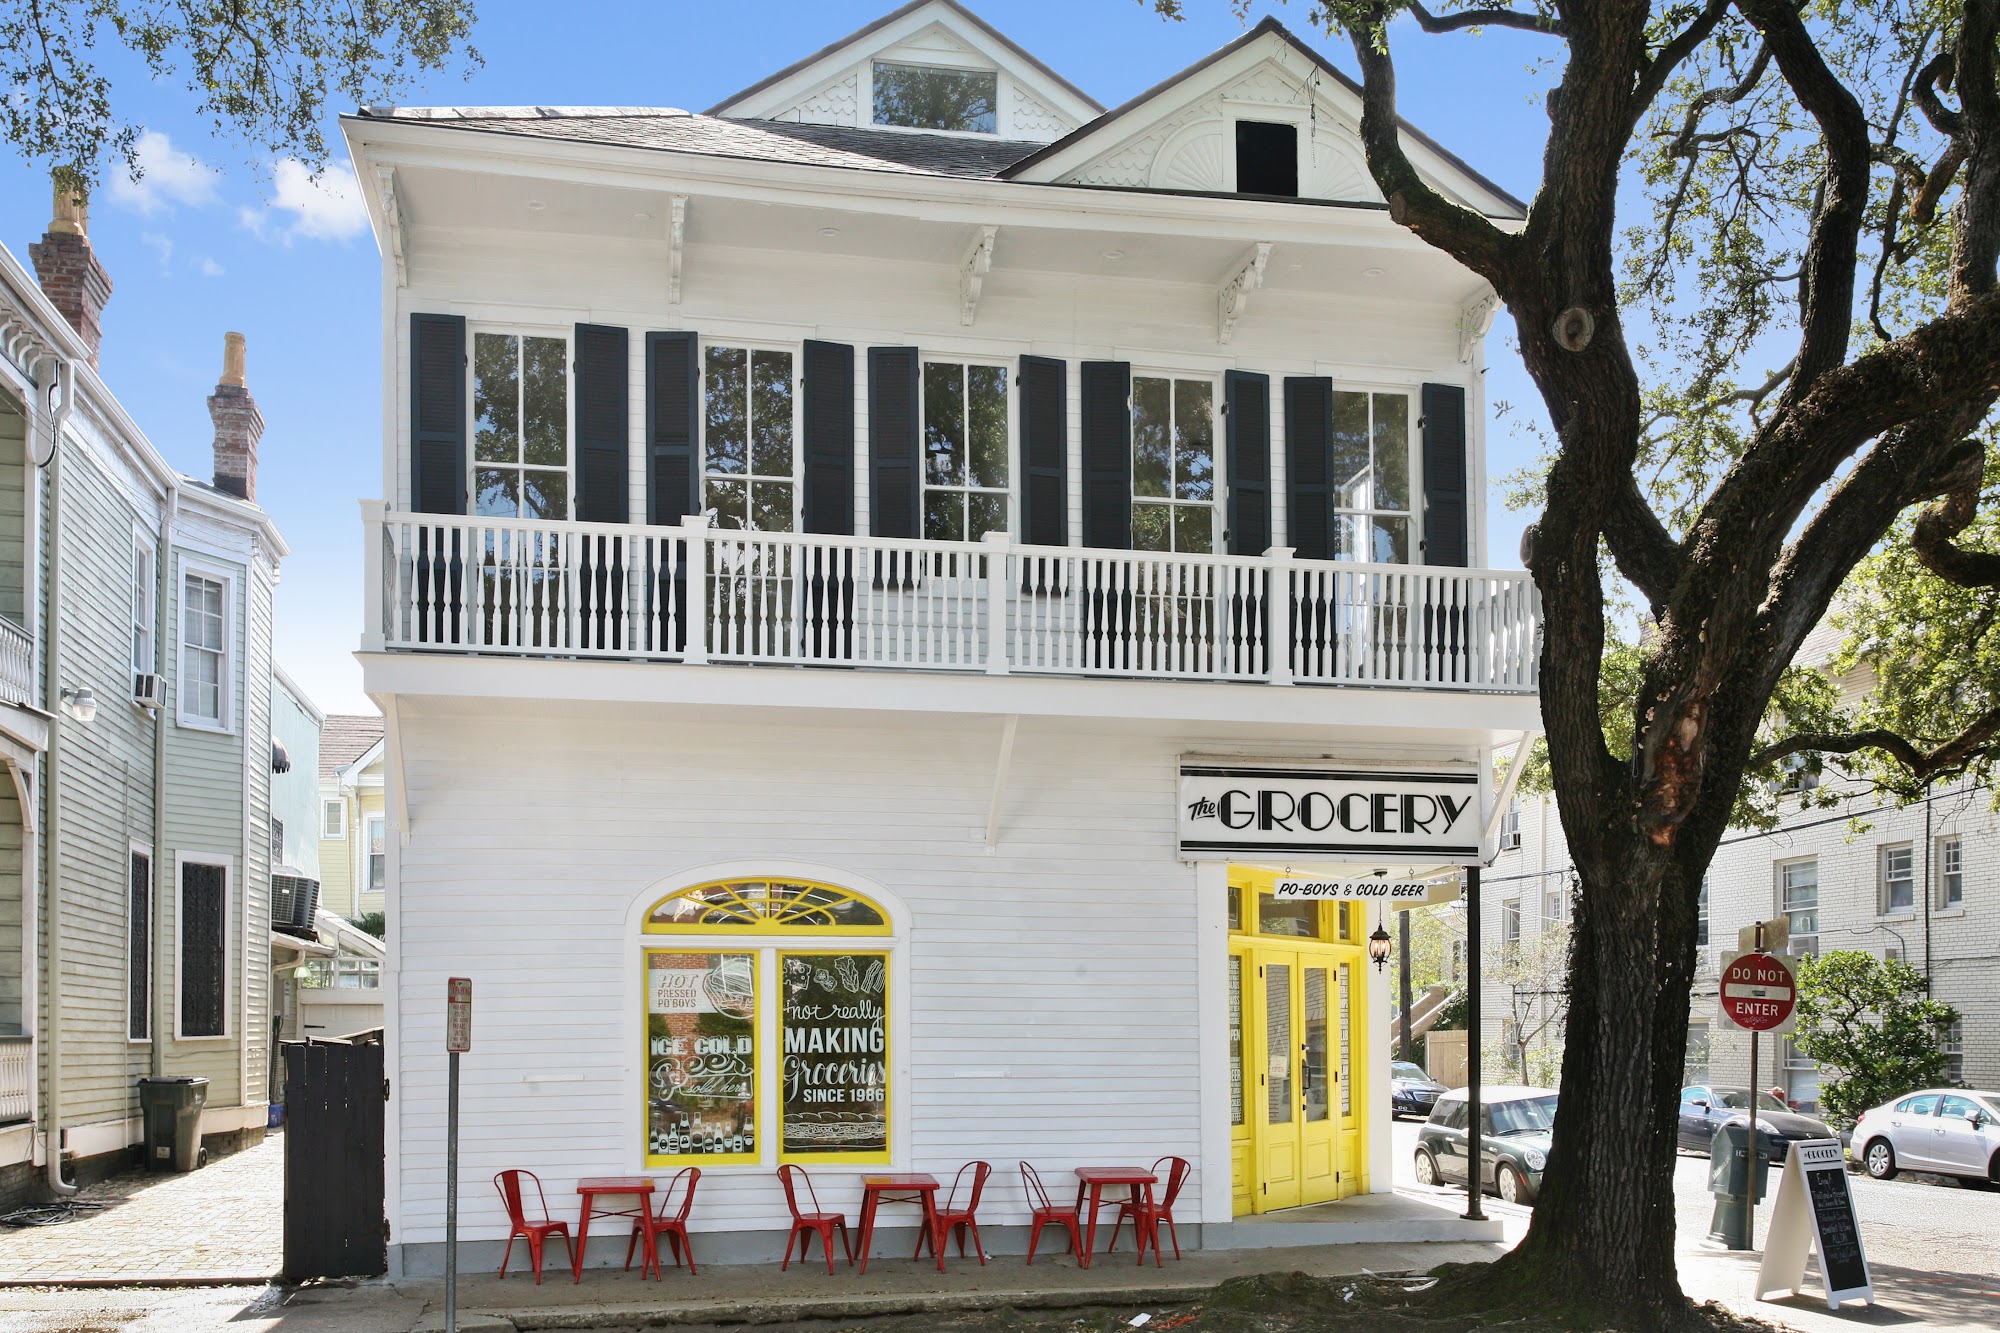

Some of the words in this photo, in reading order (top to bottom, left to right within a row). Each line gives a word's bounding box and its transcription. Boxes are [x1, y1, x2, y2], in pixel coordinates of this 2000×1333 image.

[1188, 796, 1216, 821] The
[1217, 789, 1472, 835] GROCERY
[1278, 883, 1339, 896] PO-BOYS
[1343, 884, 1352, 896] &
[1356, 884, 1388, 896] COLD
[1391, 885, 1425, 896] BEER
[659, 973, 699, 988] HOT
[1732, 967, 1751, 980] DO
[1757, 969, 1785, 982] NOT
[657, 989, 697, 998] PRESSED
[822, 999, 886, 1030] really
[1735, 1002, 1779, 1016] ENTER
[651, 1035, 688, 1056] ICE
[694, 1035, 753, 1055] COLD
[784, 1027, 885, 1054] MAKING
[650, 1053, 754, 1101] Beer
[687, 1076, 724, 1093] sold
[783, 1054, 886, 1104] Groceries
[803, 1088, 845, 1103] SINCE
[849, 1088, 885, 1102] 1986
